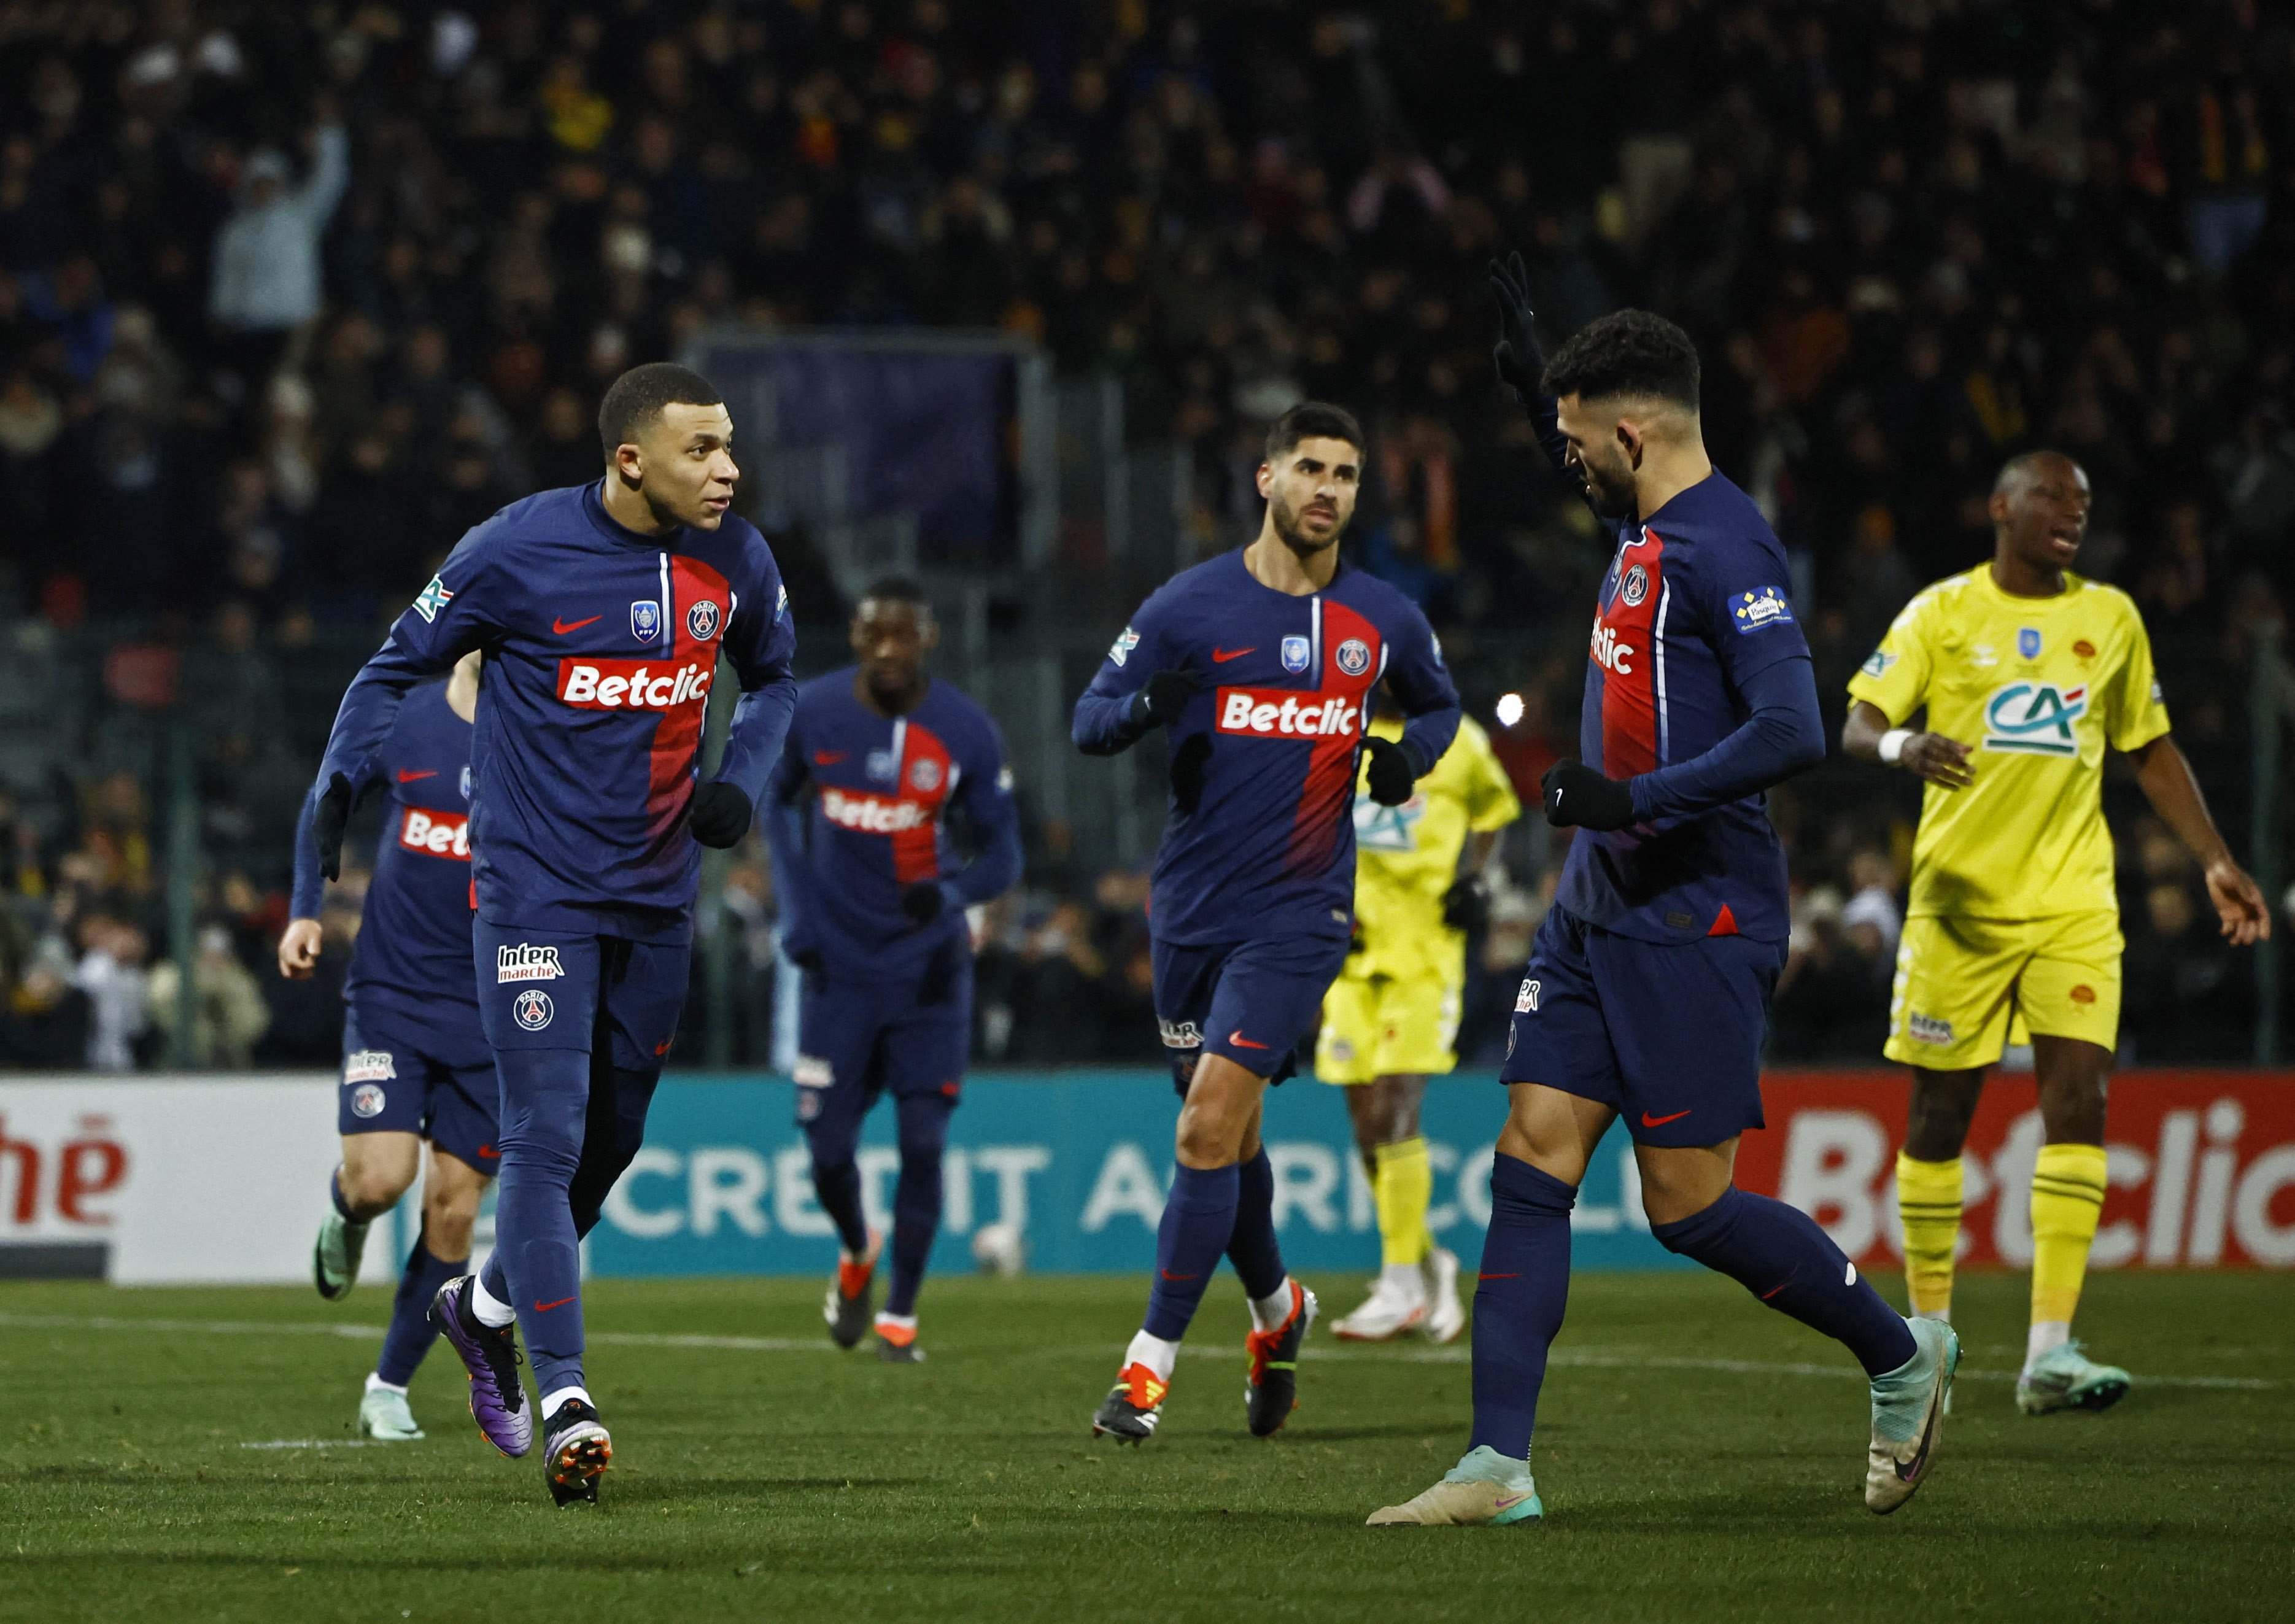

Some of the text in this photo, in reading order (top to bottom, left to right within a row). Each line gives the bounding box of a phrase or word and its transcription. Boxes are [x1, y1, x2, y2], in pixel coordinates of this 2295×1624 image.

[693, 602, 716, 613] PARIS
[563, 663, 710, 706] Betclic
[1221, 694, 1358, 735] Betclic
[404, 810, 470, 856] Bet
[519, 991, 546, 1003] PARIS
